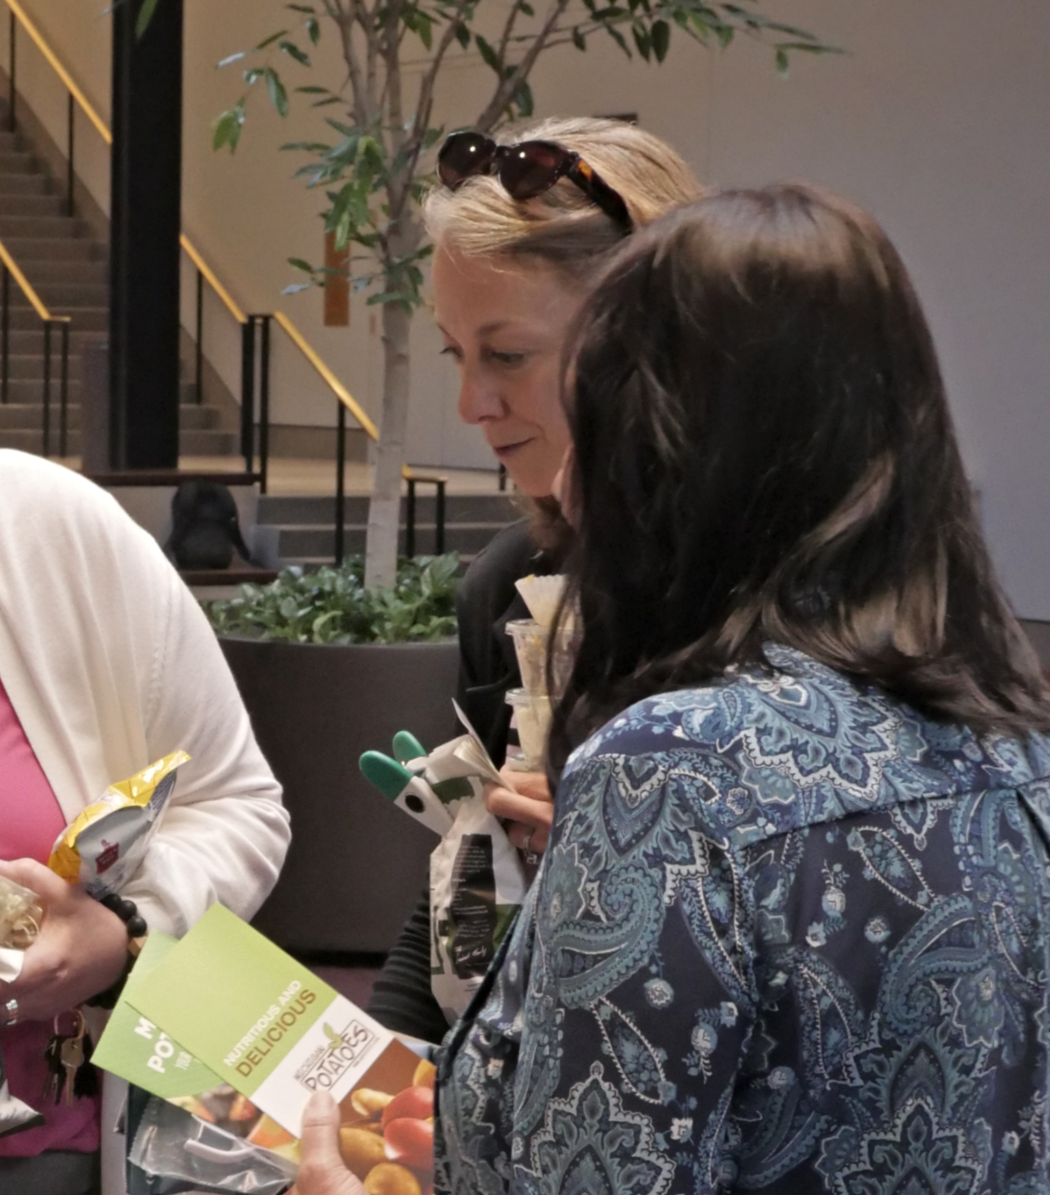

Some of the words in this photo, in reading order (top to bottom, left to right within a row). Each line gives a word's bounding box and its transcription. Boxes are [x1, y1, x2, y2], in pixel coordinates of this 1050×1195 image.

[223, 1004, 281, 1067] NUTRITIOUS
[277, 979, 303, 1007] AND
[235, 988, 317, 1079] DELICIOUS
[305, 1024, 369, 1091] POTATOES
